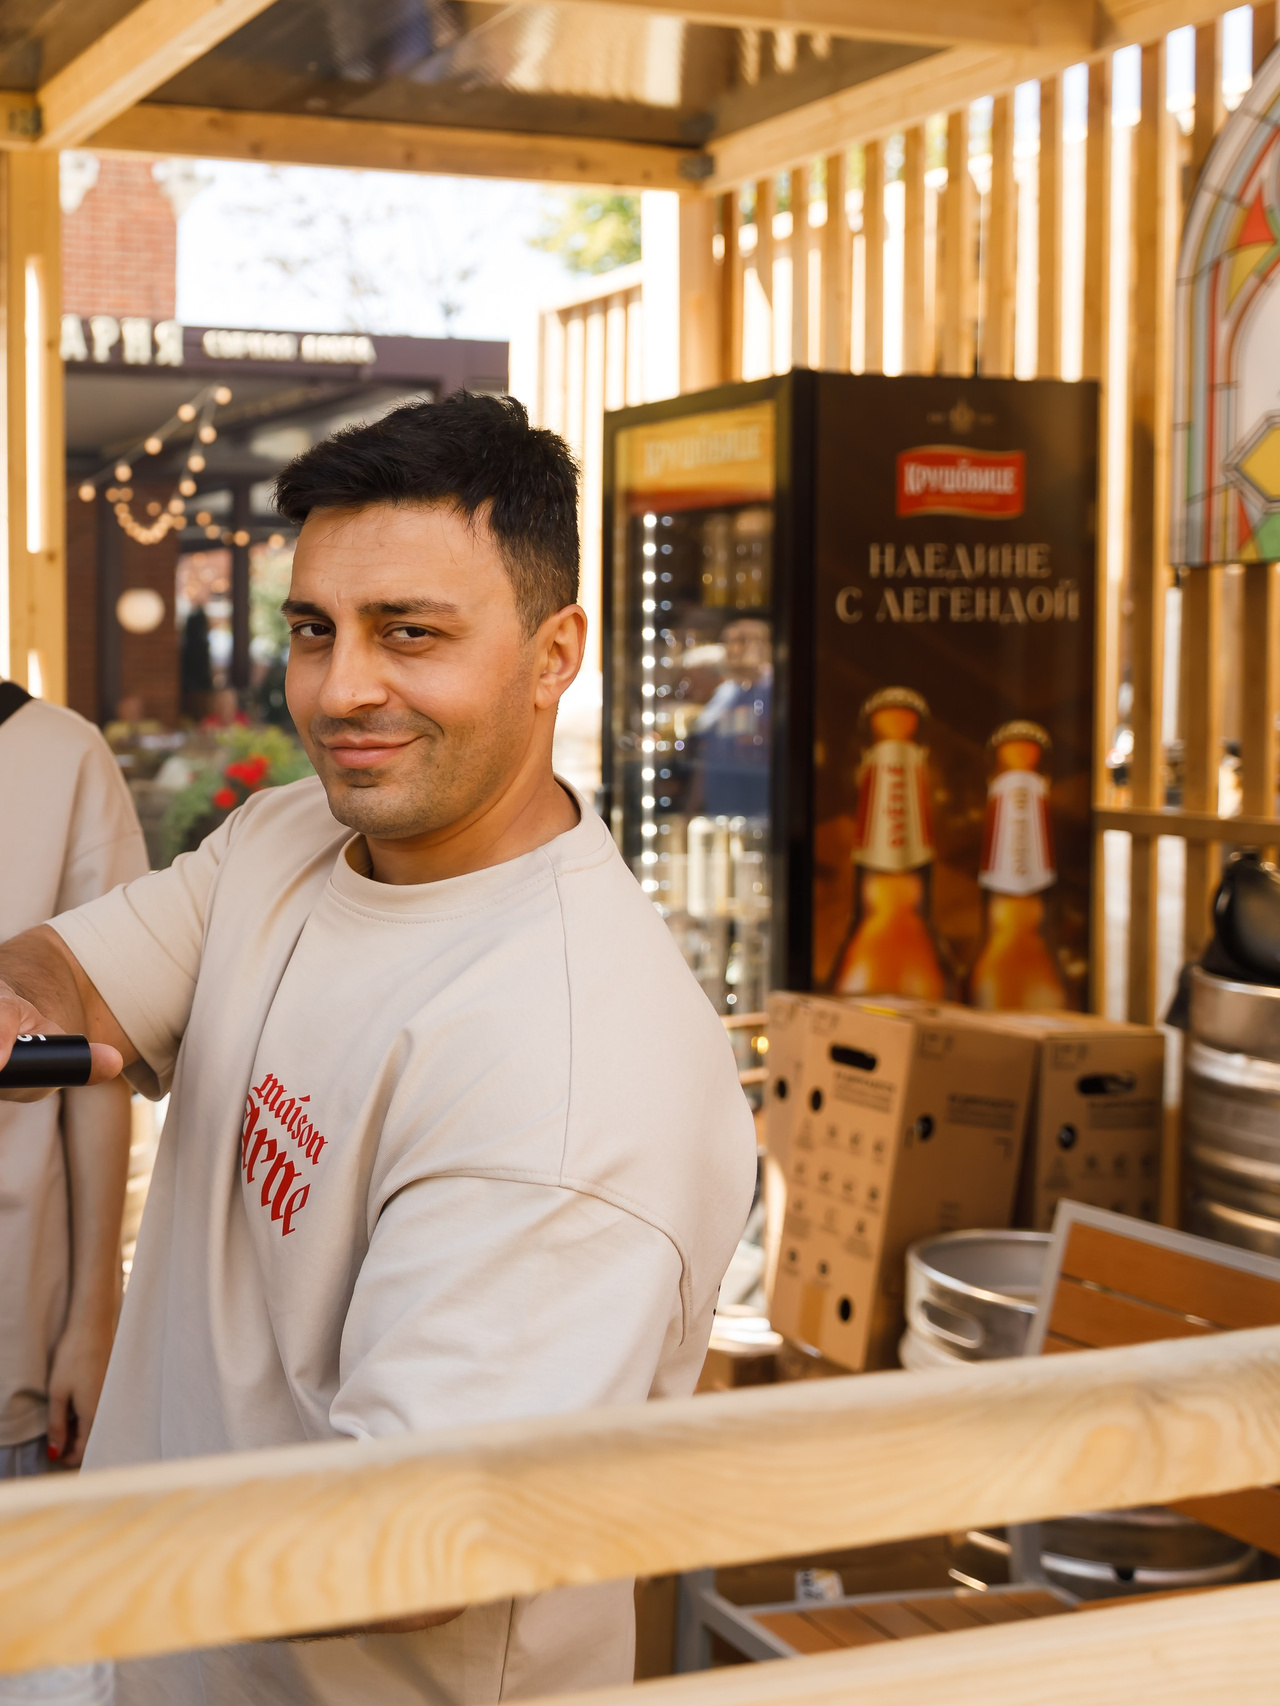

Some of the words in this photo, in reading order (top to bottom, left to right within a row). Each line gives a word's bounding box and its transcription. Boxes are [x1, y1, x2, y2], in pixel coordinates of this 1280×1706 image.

[869, 543, 1052, 581] НАЕДИНЕ
[835, 585, 864, 625] С
[875, 578, 1081, 625] ЛЕГЕНДОЙ
